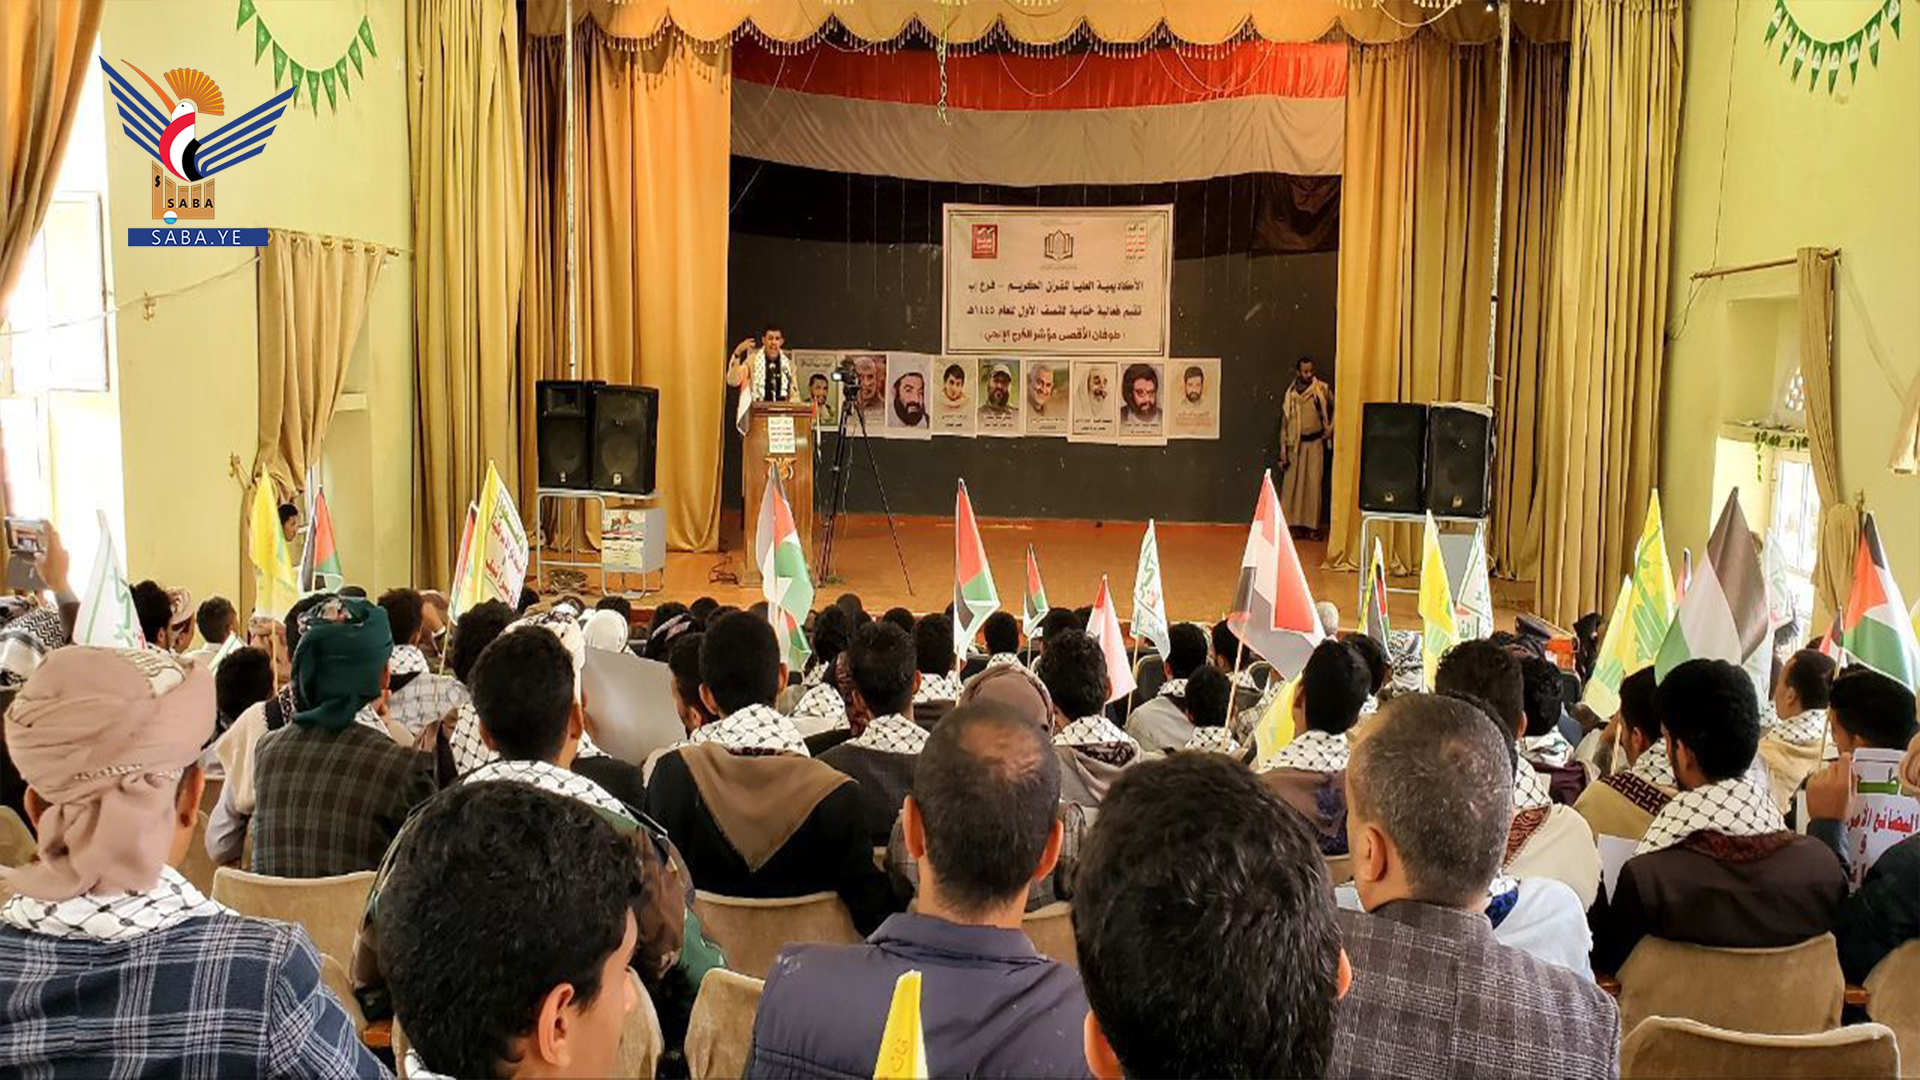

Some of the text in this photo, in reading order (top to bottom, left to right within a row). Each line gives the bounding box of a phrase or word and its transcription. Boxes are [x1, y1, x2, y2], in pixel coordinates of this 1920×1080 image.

[1007, 280, 1043, 293] الكريم
[1073, 280, 1094, 293] العليا
[1097, 279, 1143, 293] الأكاديمية
[1069, 305, 1094, 318] ختامية
[1097, 305, 1121, 317] فعالية
[1847, 802, 1919, 839] البضائع الأمر
